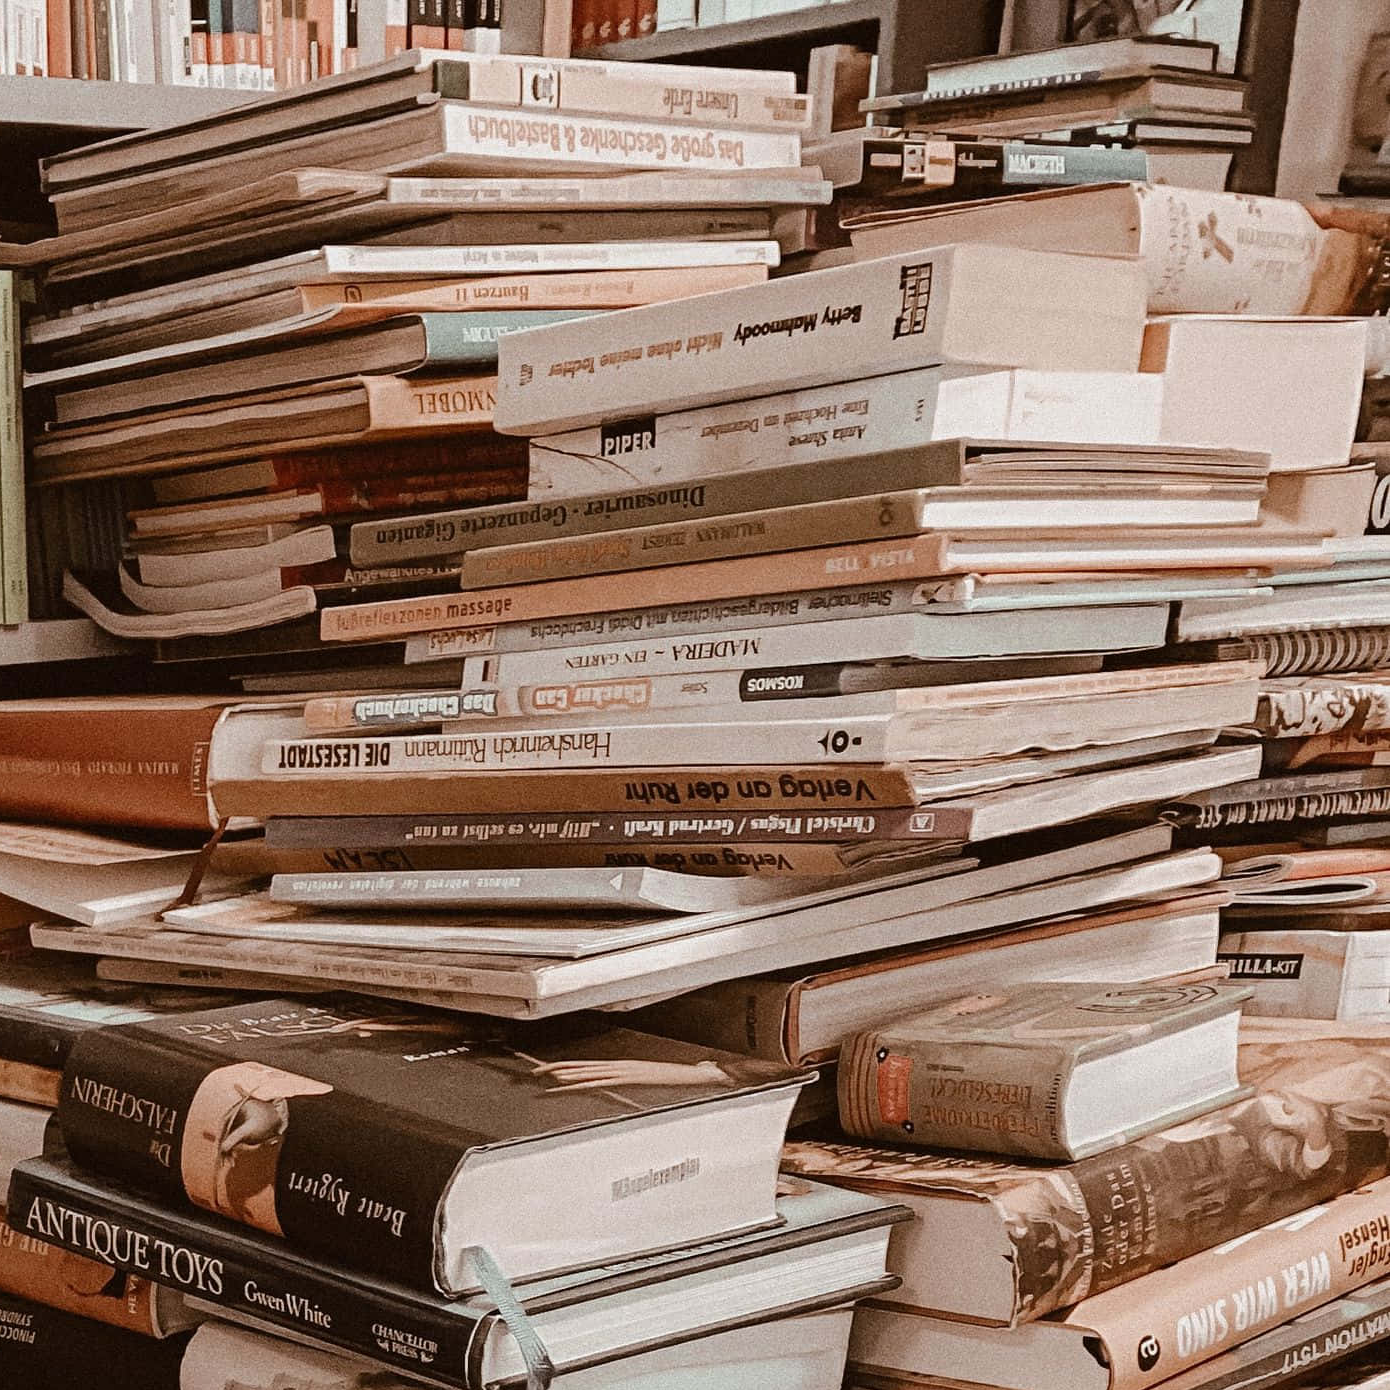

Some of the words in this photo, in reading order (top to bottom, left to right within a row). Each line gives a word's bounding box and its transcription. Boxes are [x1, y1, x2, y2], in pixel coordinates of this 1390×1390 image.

[465, 114, 561, 150] Bastelbuch
[562, 126, 578, 151] &
[579, 124, 668, 159] Geschenke
[670, 130, 716, 162] große
[717, 139, 744, 164] Das
[731, 309, 820, 347] Mahmoody
[819, 300, 864, 328] Betty
[602, 430, 654, 457] PIPER
[581, 484, 708, 522] Dinosaurier
[373, 515, 455, 550] Giganten
[458, 499, 567, 539] Gepanzerte
[445, 597, 514, 621] massage
[563, 651, 619, 670] GARTEN
[622, 648, 647, 663] EIN
[670, 636, 762, 662] MADEIRA
[746, 673, 805, 692] KOSMOS
[276, 741, 361, 769] LESESTADT
[364, 741, 392, 766] DIE
[493, 731, 611, 762] Hansheinrich
[624, 781, 680, 805] Ruhr
[686, 779, 730, 803] der
[732, 778, 773, 799] an
[779, 771, 876, 803] Verlag
[441, 823, 459, 837] zu
[462, 822, 505, 841] selbst
[623, 819, 666, 837] Kraft
[669, 817, 735, 837] Gertrud
[806, 814, 875, 835] Christel
[67, 1076, 178, 1136] FÄLSCHERIN
[285, 1162, 354, 1213] Rygiert
[355, 1196, 408, 1235] Beate
[1333, 1216, 1390, 1261] Hensel
[23, 1197, 156, 1273] ANTIQUE
[147, 1240, 230, 1294] TOYS
[241, 1280, 289, 1311] Gwen
[280, 1293, 335, 1327] White
[1274, 1254, 1336, 1306] WER
[1224, 1276, 1283, 1328] WIR
[370, 1323, 440, 1353] CHANCELLOR
[1167, 1299, 1235, 1351] SIND
[389, 1340, 419, 1357] PRESS
